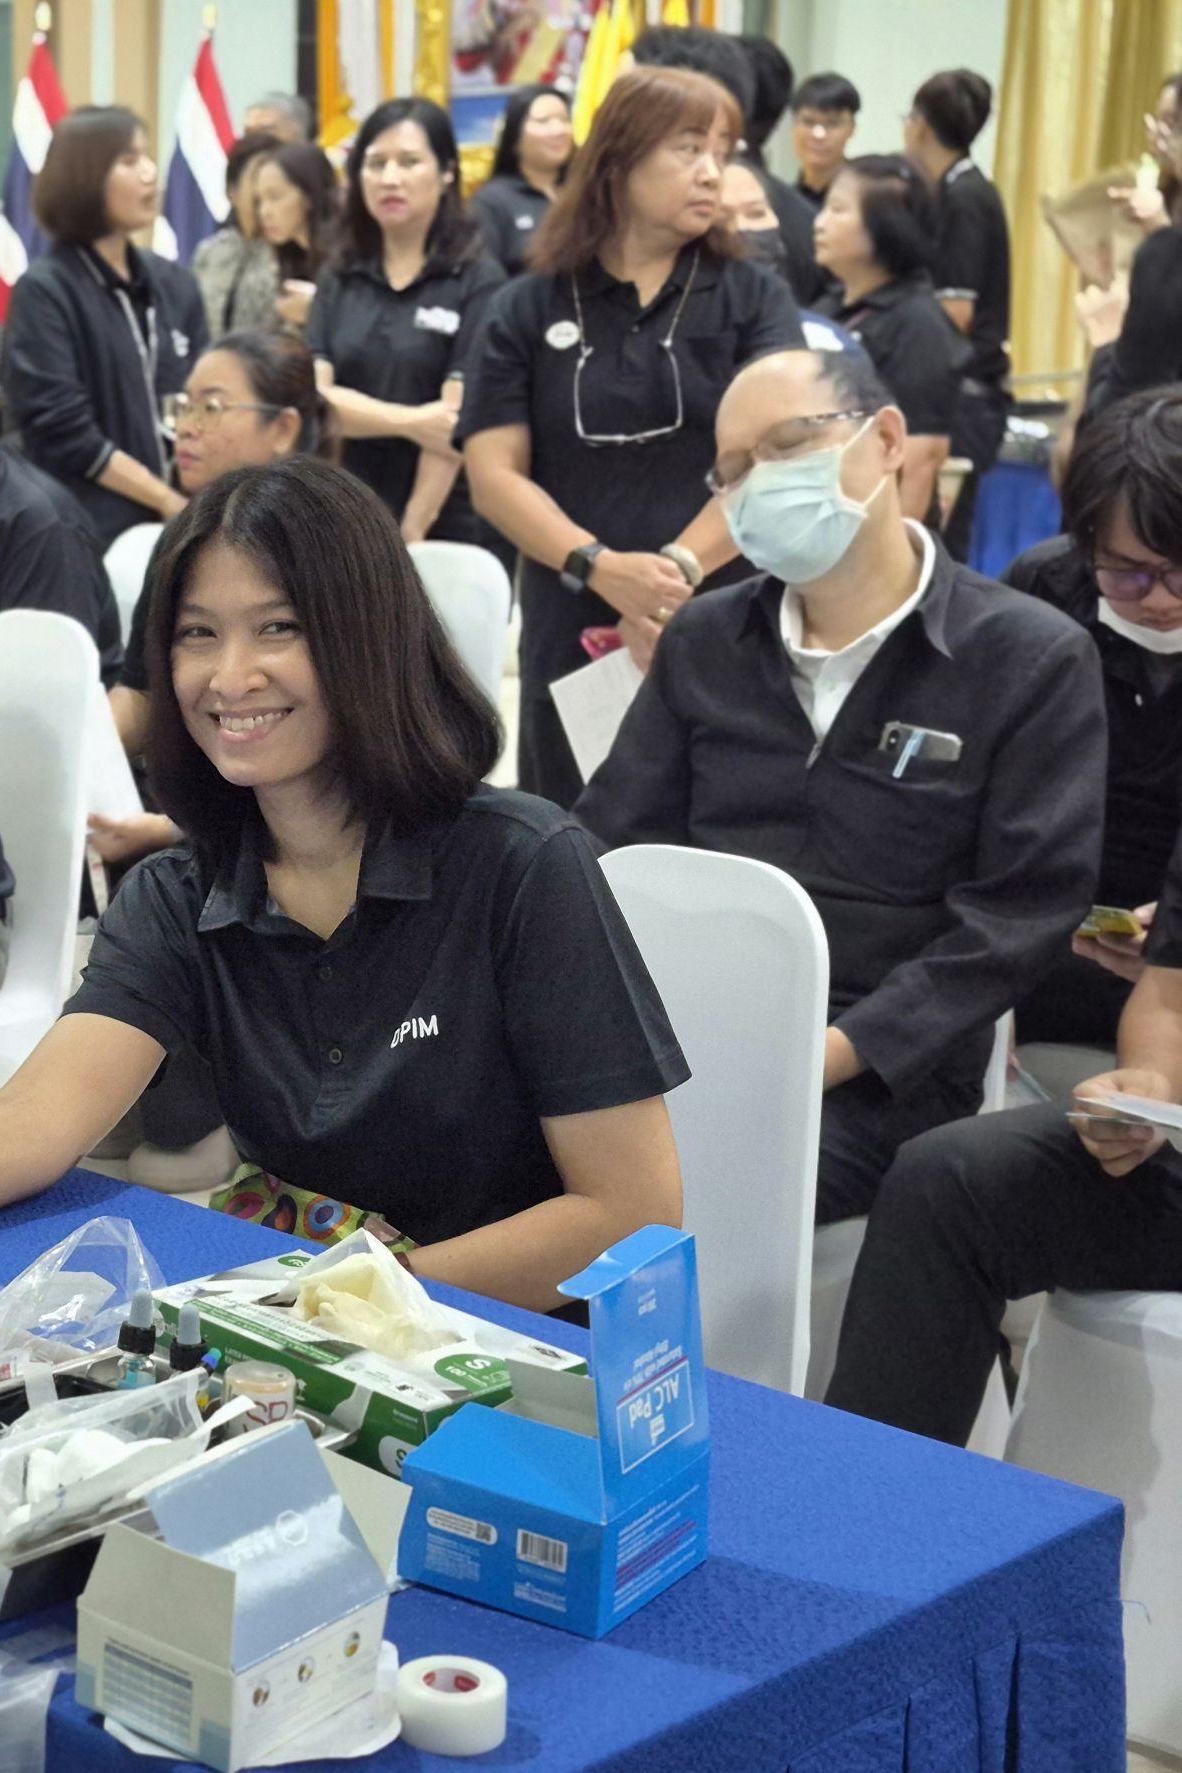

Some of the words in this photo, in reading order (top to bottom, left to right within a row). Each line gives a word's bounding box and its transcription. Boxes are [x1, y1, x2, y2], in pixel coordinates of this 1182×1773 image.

[390, 1014, 439, 1048] DPIM
[465, 1358, 491, 1370] S
[654, 1373, 680, 1412] ALC
[628, 1392, 652, 1429] Pad
